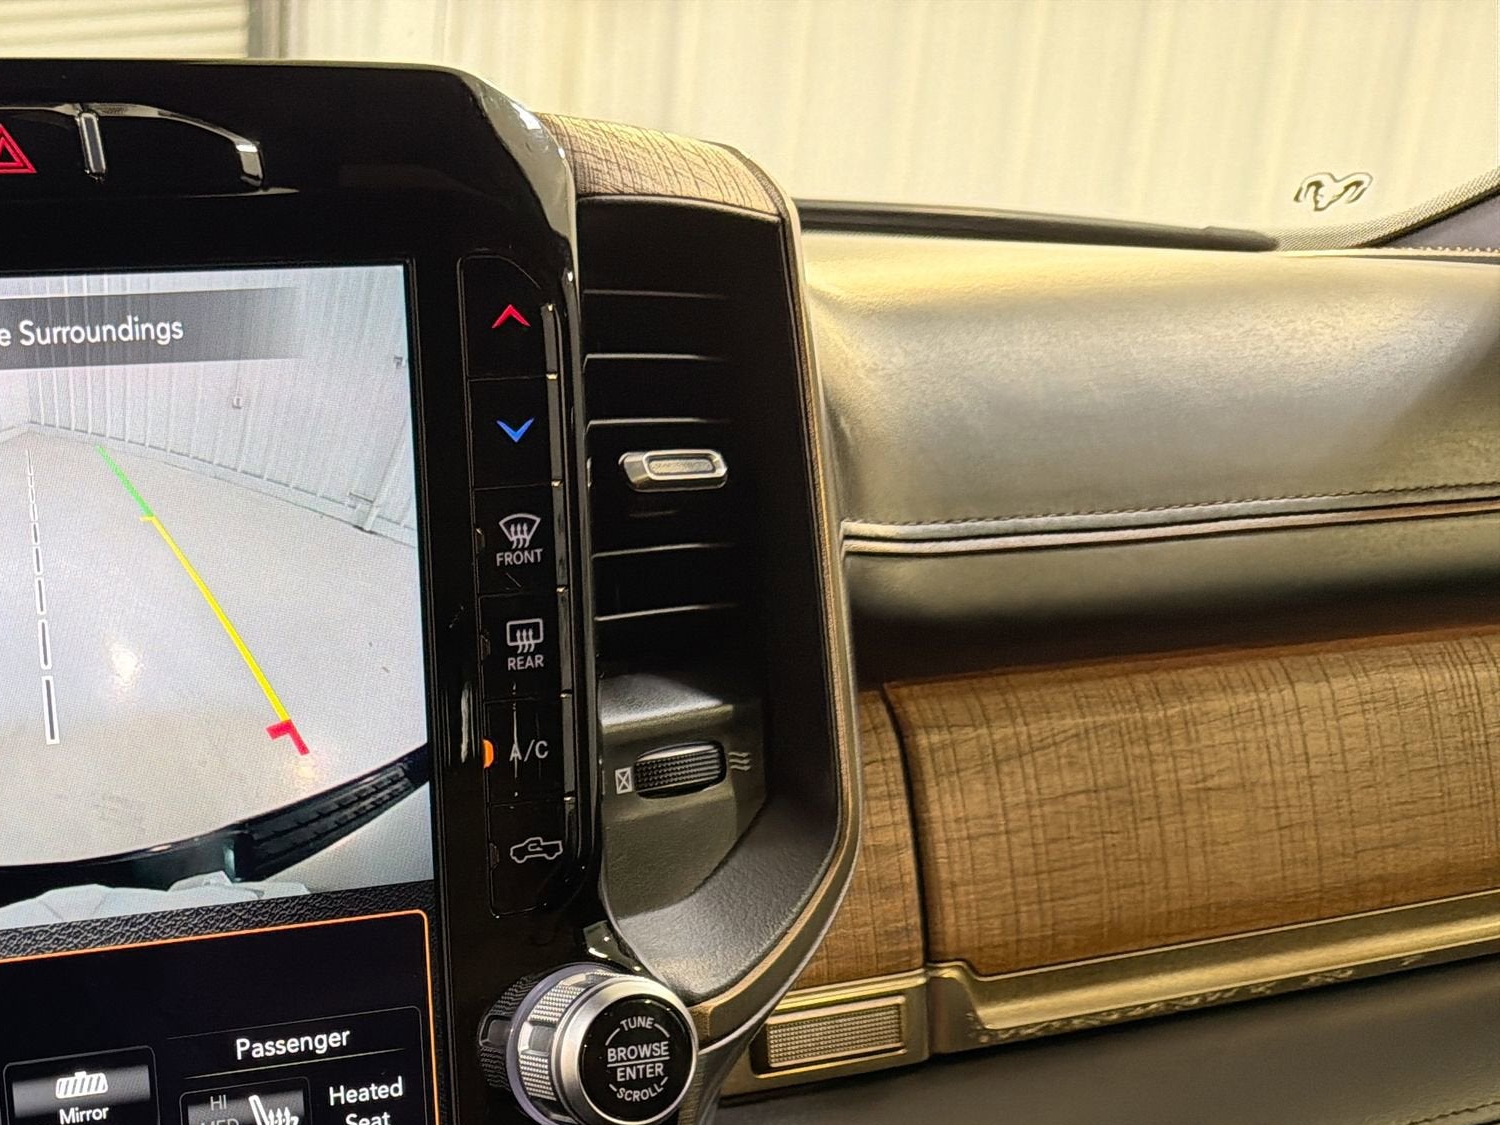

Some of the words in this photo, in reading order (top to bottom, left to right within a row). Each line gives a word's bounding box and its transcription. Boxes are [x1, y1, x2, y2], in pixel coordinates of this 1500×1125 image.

[19, 317, 184, 346] Surroundings
[496, 548, 542, 567] FRONT
[506, 653, 544, 670] REAR
[510, 740, 549, 761] A/C
[620, 1014, 654, 1032] TUNE
[235, 1028, 351, 1060] Passenger
[606, 1042, 669, 1063] BROWSE
[616, 1062, 665, 1081] ENTER
[329, 1078, 403, 1107] Heated
[615, 1082, 664, 1102] SCROLL
[209, 1095, 228, 1111] HI
[59, 1104, 109, 1125] Mirror
